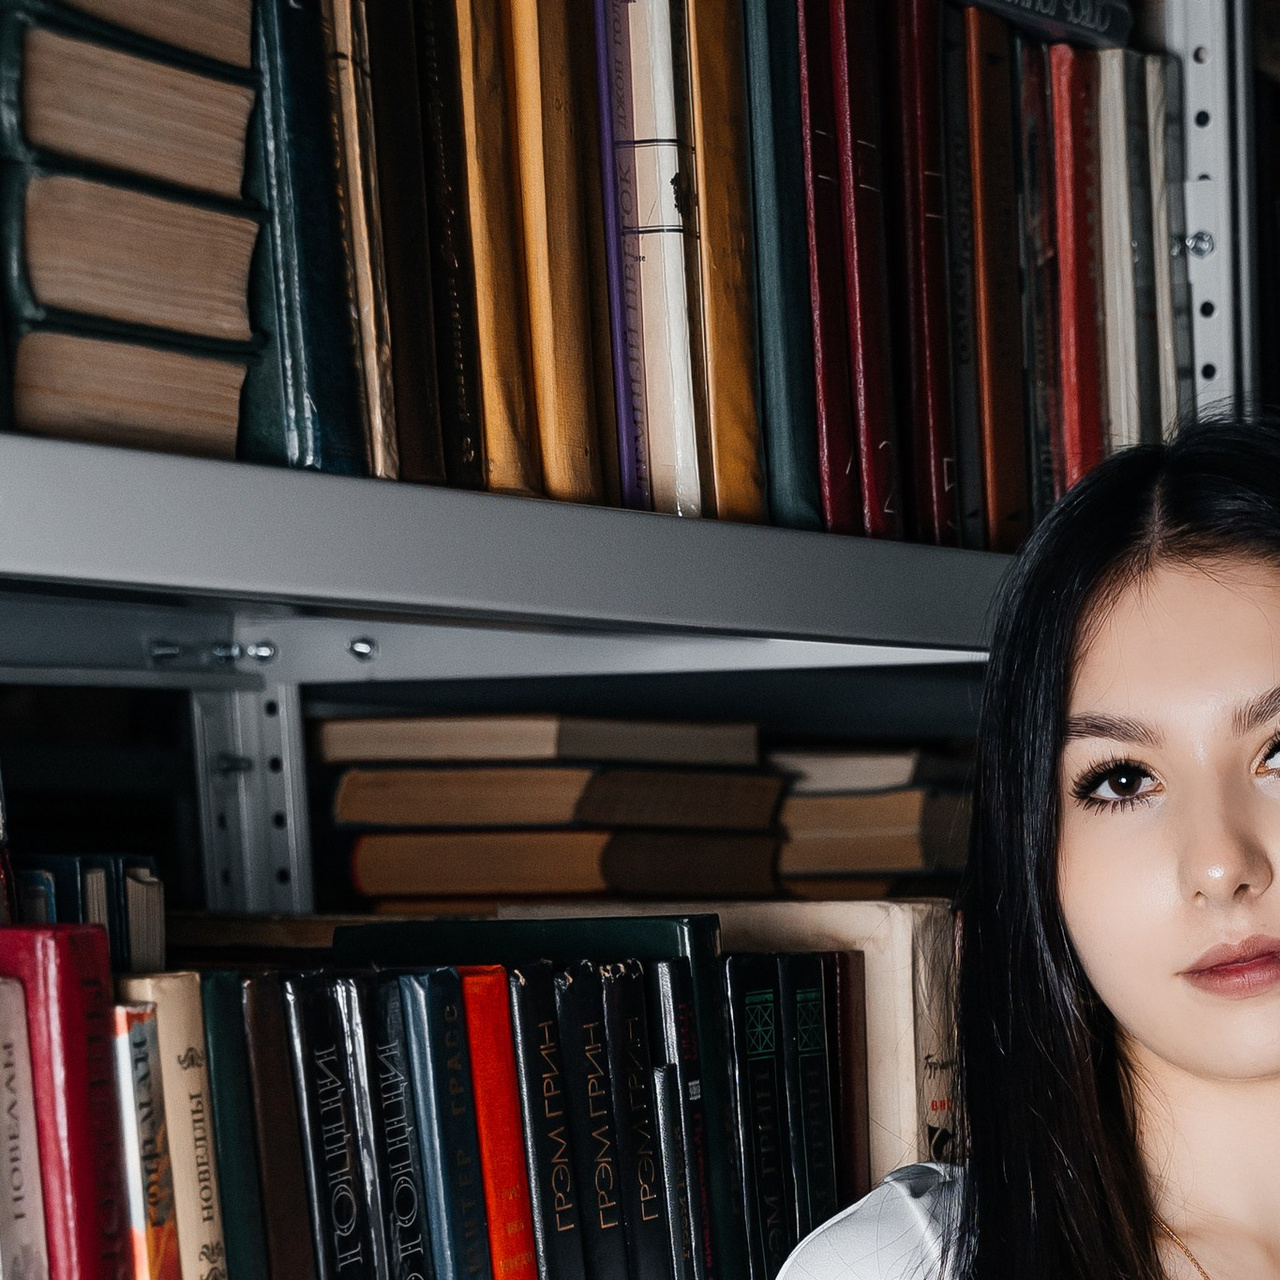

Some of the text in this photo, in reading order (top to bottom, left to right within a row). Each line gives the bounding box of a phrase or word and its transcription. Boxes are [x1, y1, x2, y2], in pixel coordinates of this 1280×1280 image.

[189, 1092, 215, 1222] НОВЕЛЛЫ
[315, 1043, 364, 1272] ГОЦЦИ
[377, 1039, 423, 1258] ГОЦЦИ
[538, 1022, 575, 1231] ГРЭМ ГРИН
[583, 1021, 618, 1230] ГРЭМ ГРИН
[626, 1017, 658, 1221] ГРЭМ ГРИН
